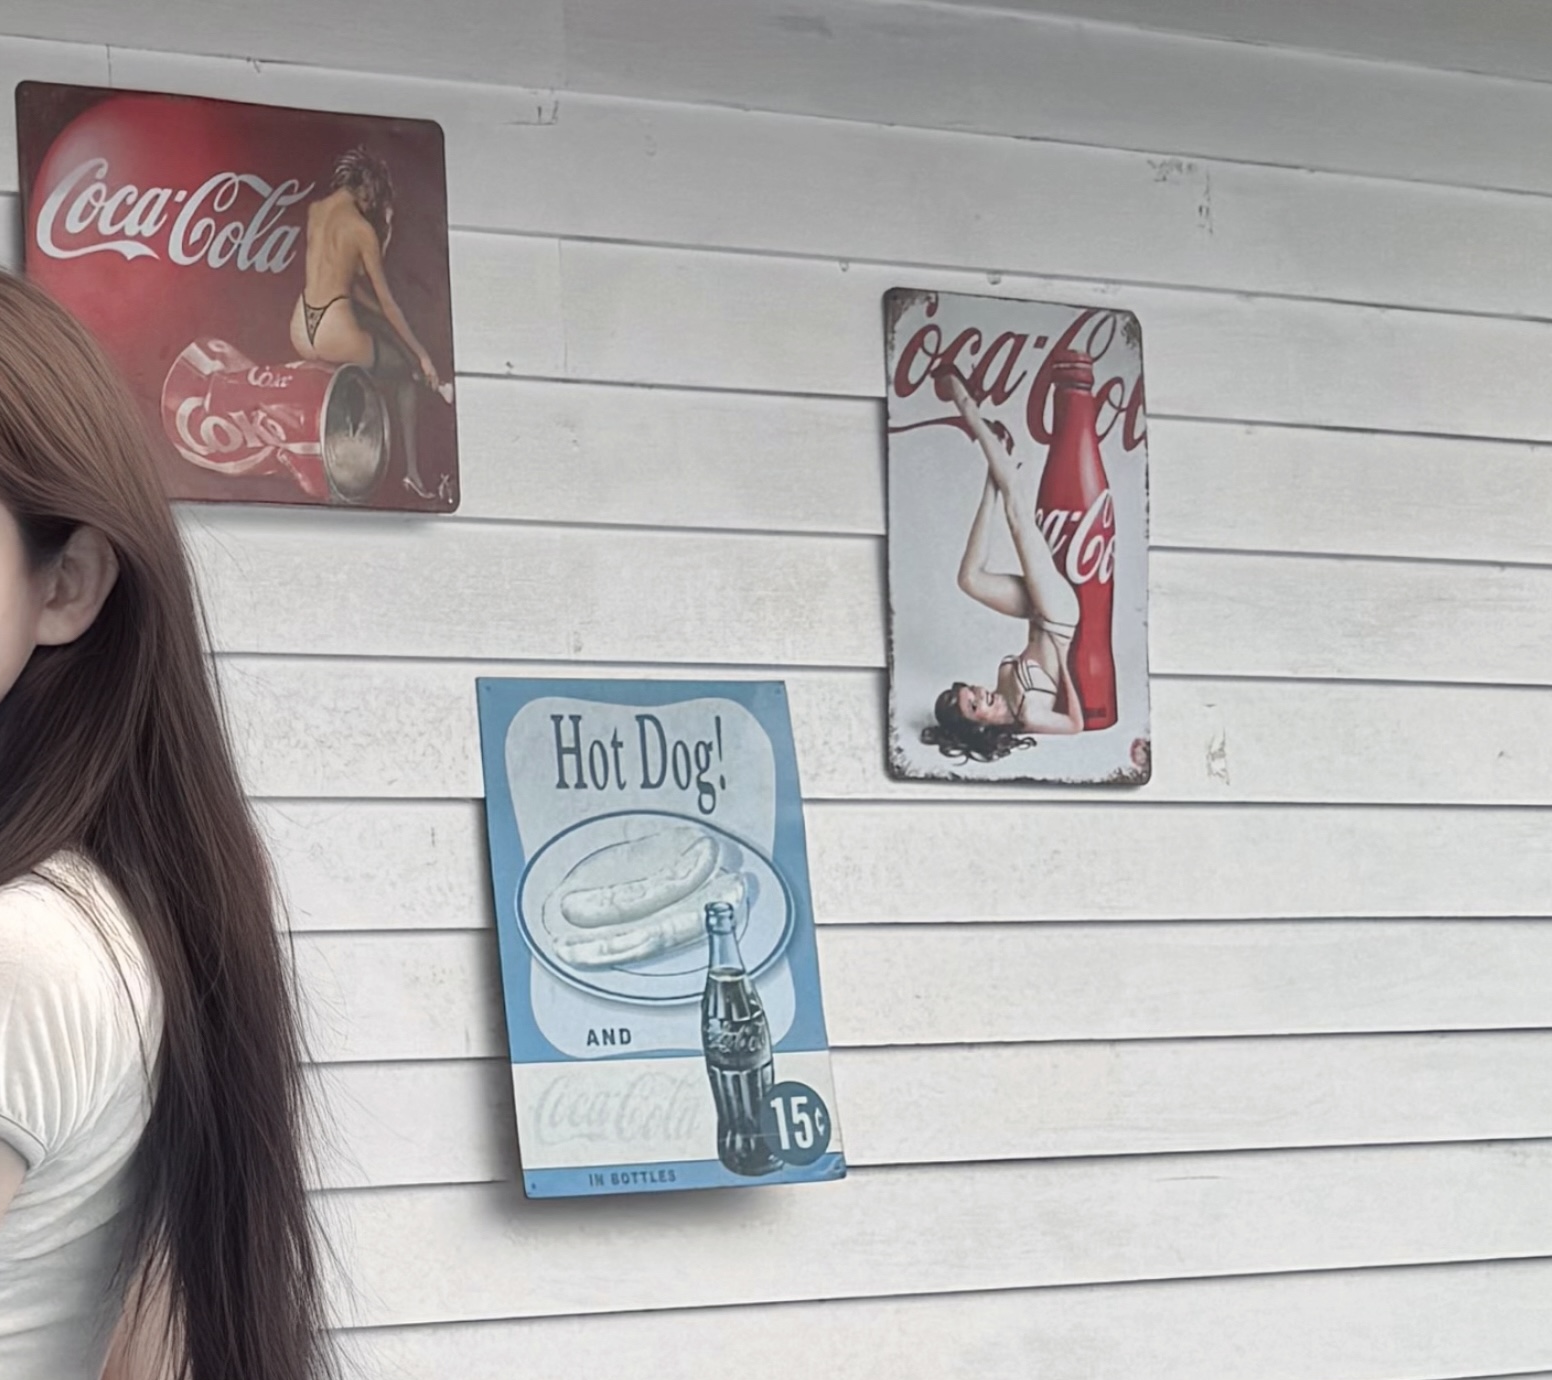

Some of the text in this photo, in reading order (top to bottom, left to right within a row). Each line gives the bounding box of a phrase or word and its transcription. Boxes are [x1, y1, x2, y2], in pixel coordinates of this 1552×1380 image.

[36, 157, 315, 273] Coca-Cola
[550, 713, 728, 815] Hot Dog!
[586, 1028, 633, 1048] AND
[770, 1095, 826, 1151] 15¢
[588, 1169, 677, 1187] IN BOTTLES
